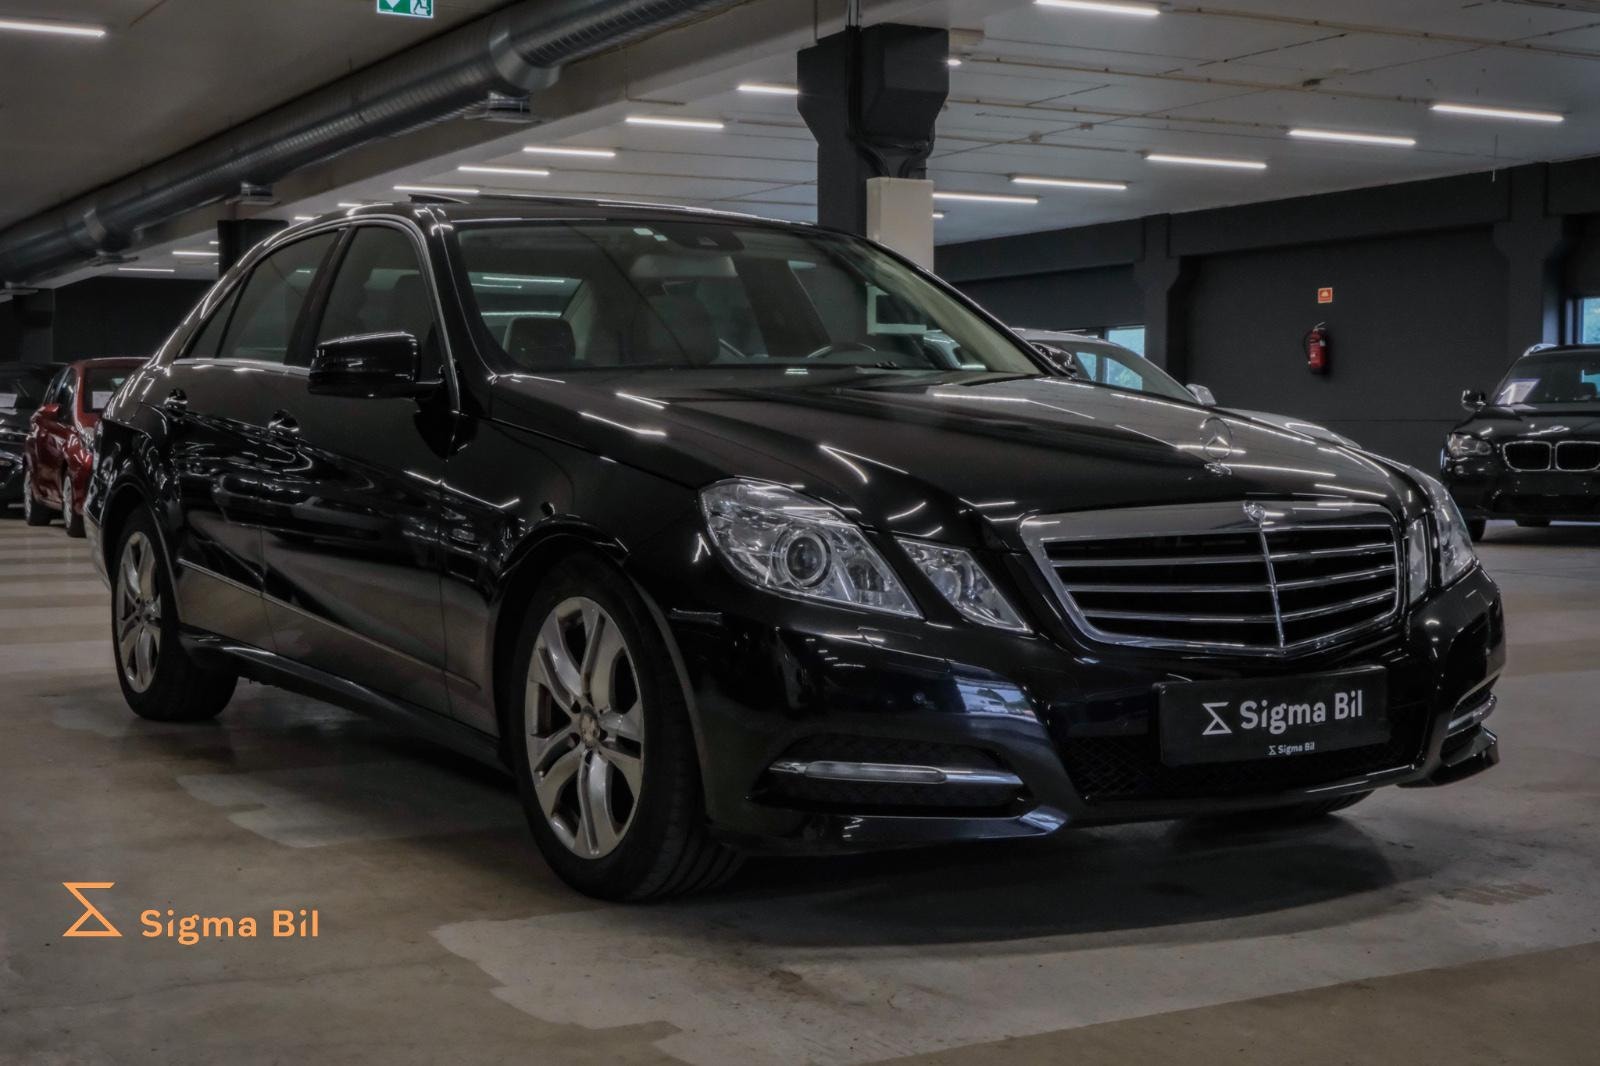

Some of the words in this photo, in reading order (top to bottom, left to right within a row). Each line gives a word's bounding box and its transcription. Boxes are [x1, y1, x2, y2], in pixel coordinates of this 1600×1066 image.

[1239, 700, 1326, 735] Sigma
[1334, 690, 1363, 720] Bil
[1278, 744, 1303, 755] Sigma
[1305, 741, 1315, 751] Bil
